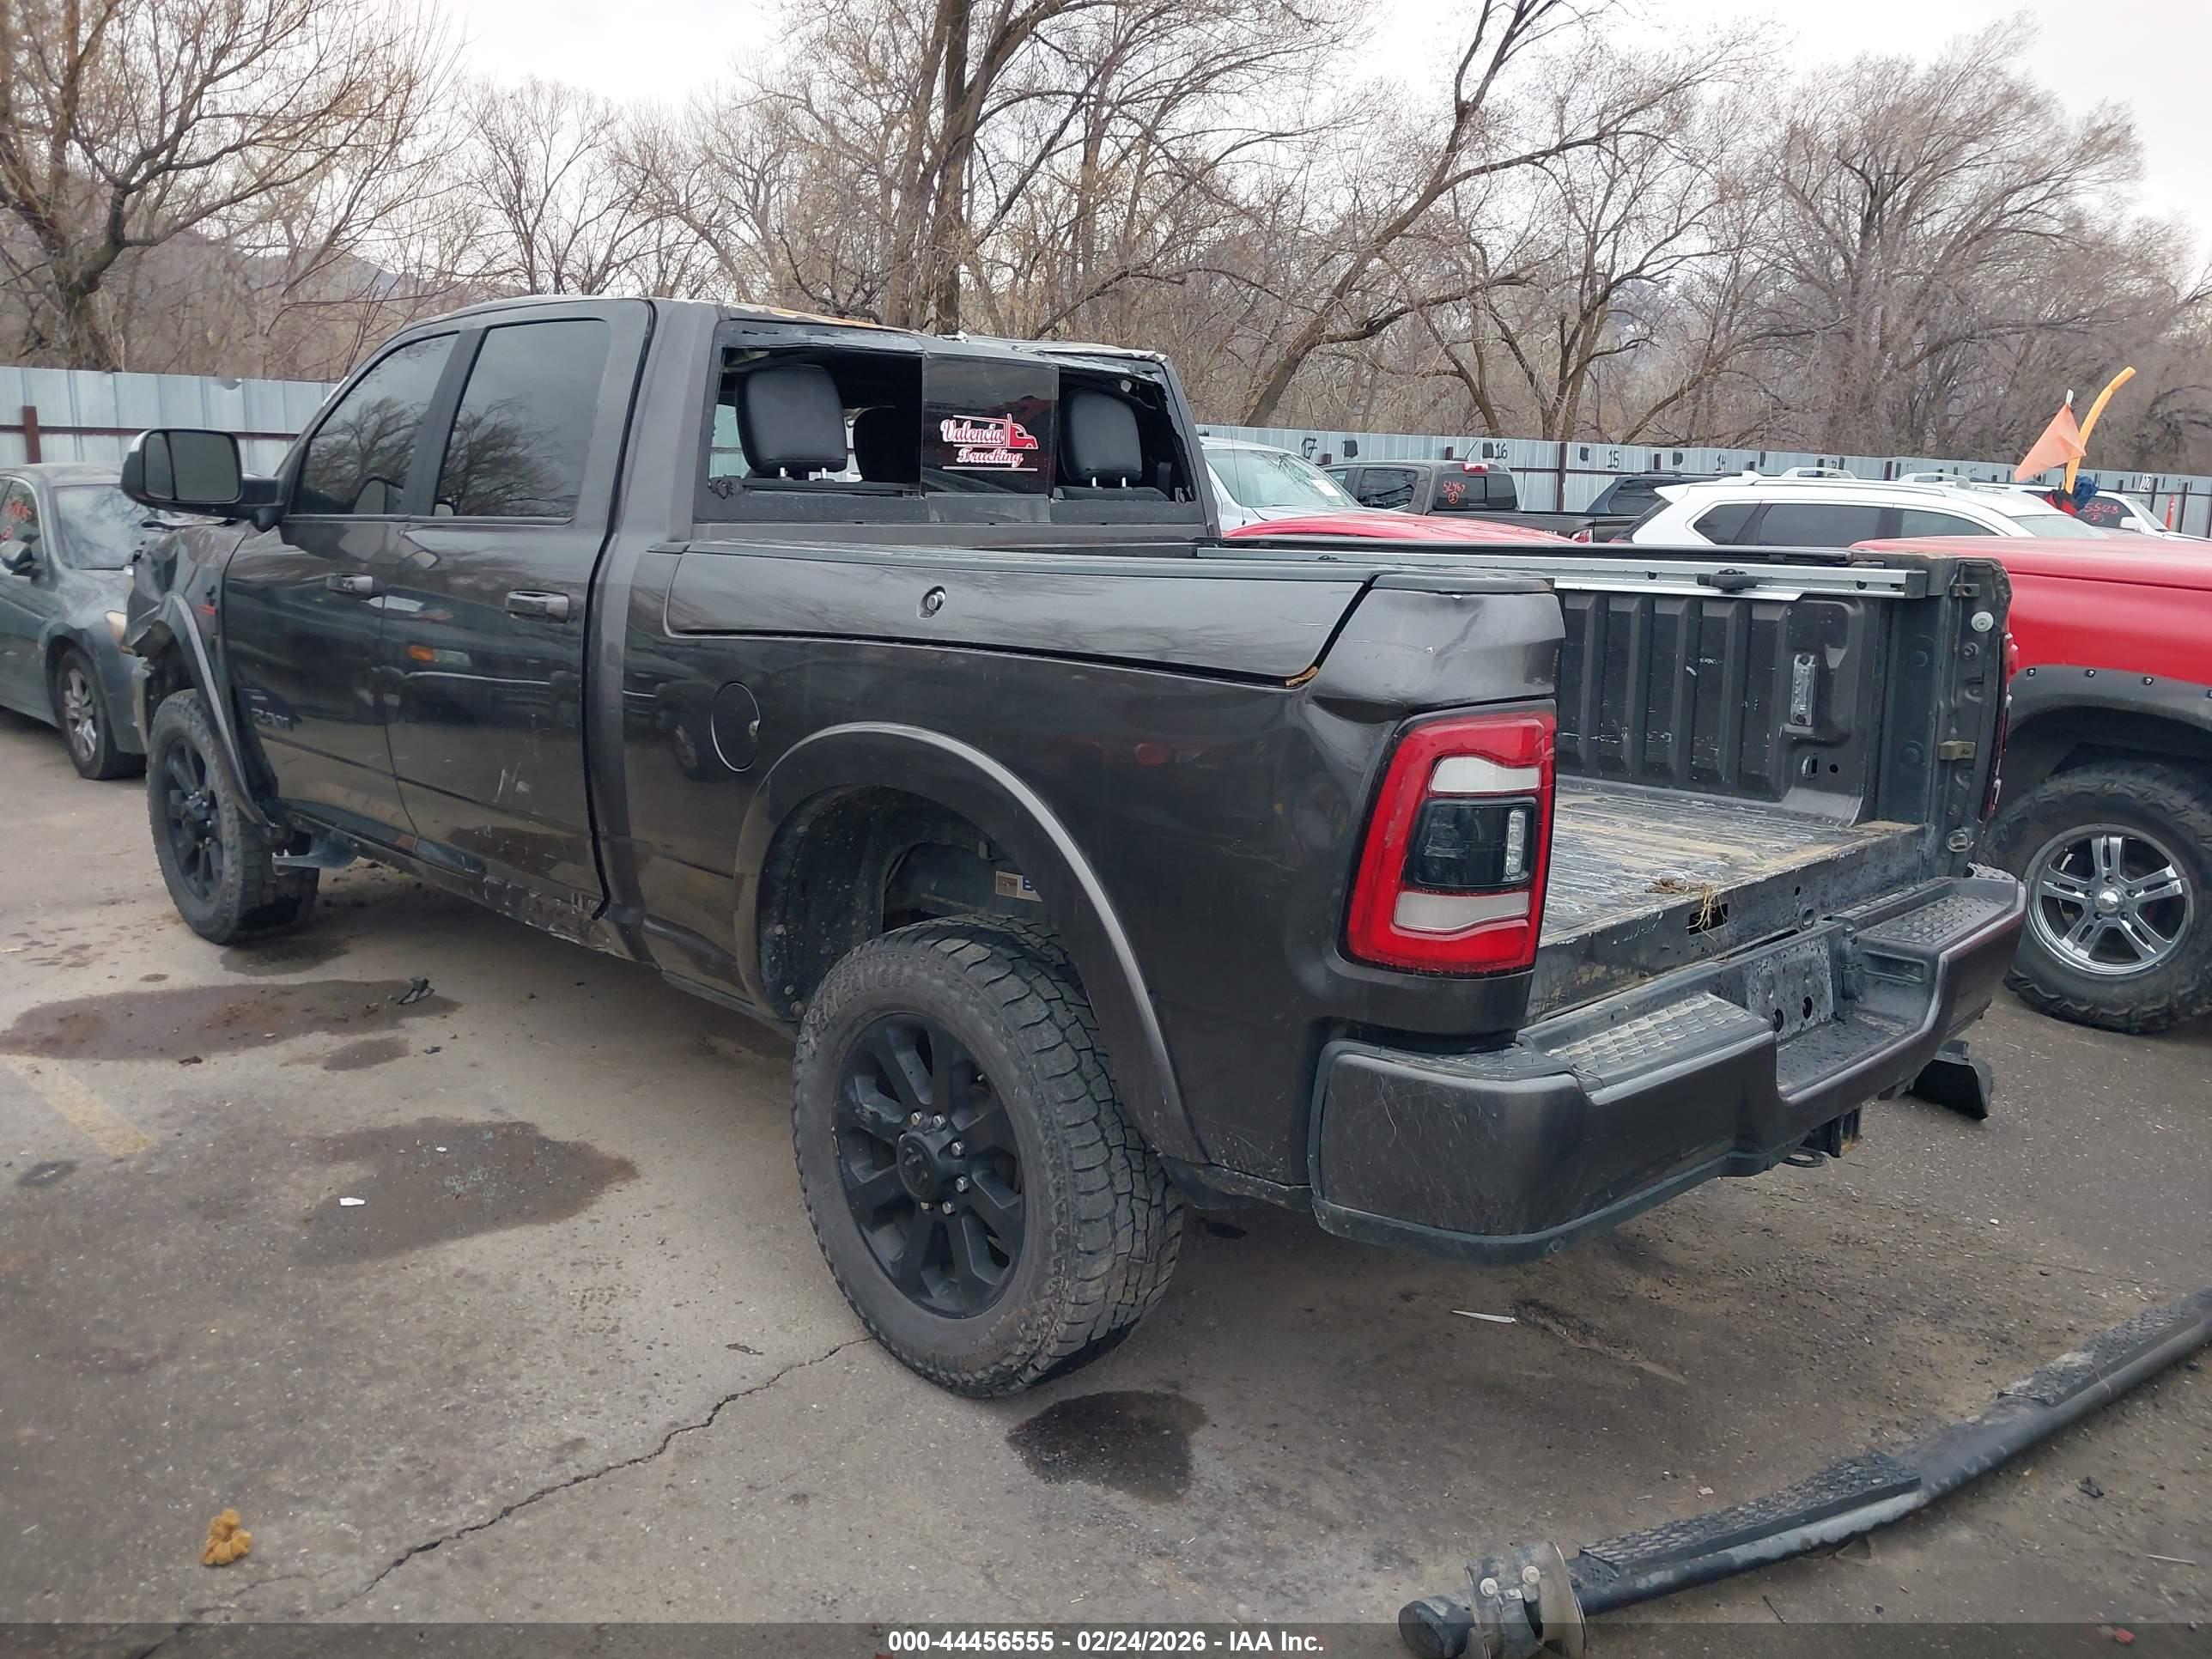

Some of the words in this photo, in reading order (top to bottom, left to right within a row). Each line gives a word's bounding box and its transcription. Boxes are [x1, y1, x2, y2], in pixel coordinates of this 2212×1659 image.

[940, 419, 1005, 443] Valencia
[956, 447, 1024, 468] Trucking
[1495, 442, 1508, 459] 16
[1607, 450, 1620, 469] 15
